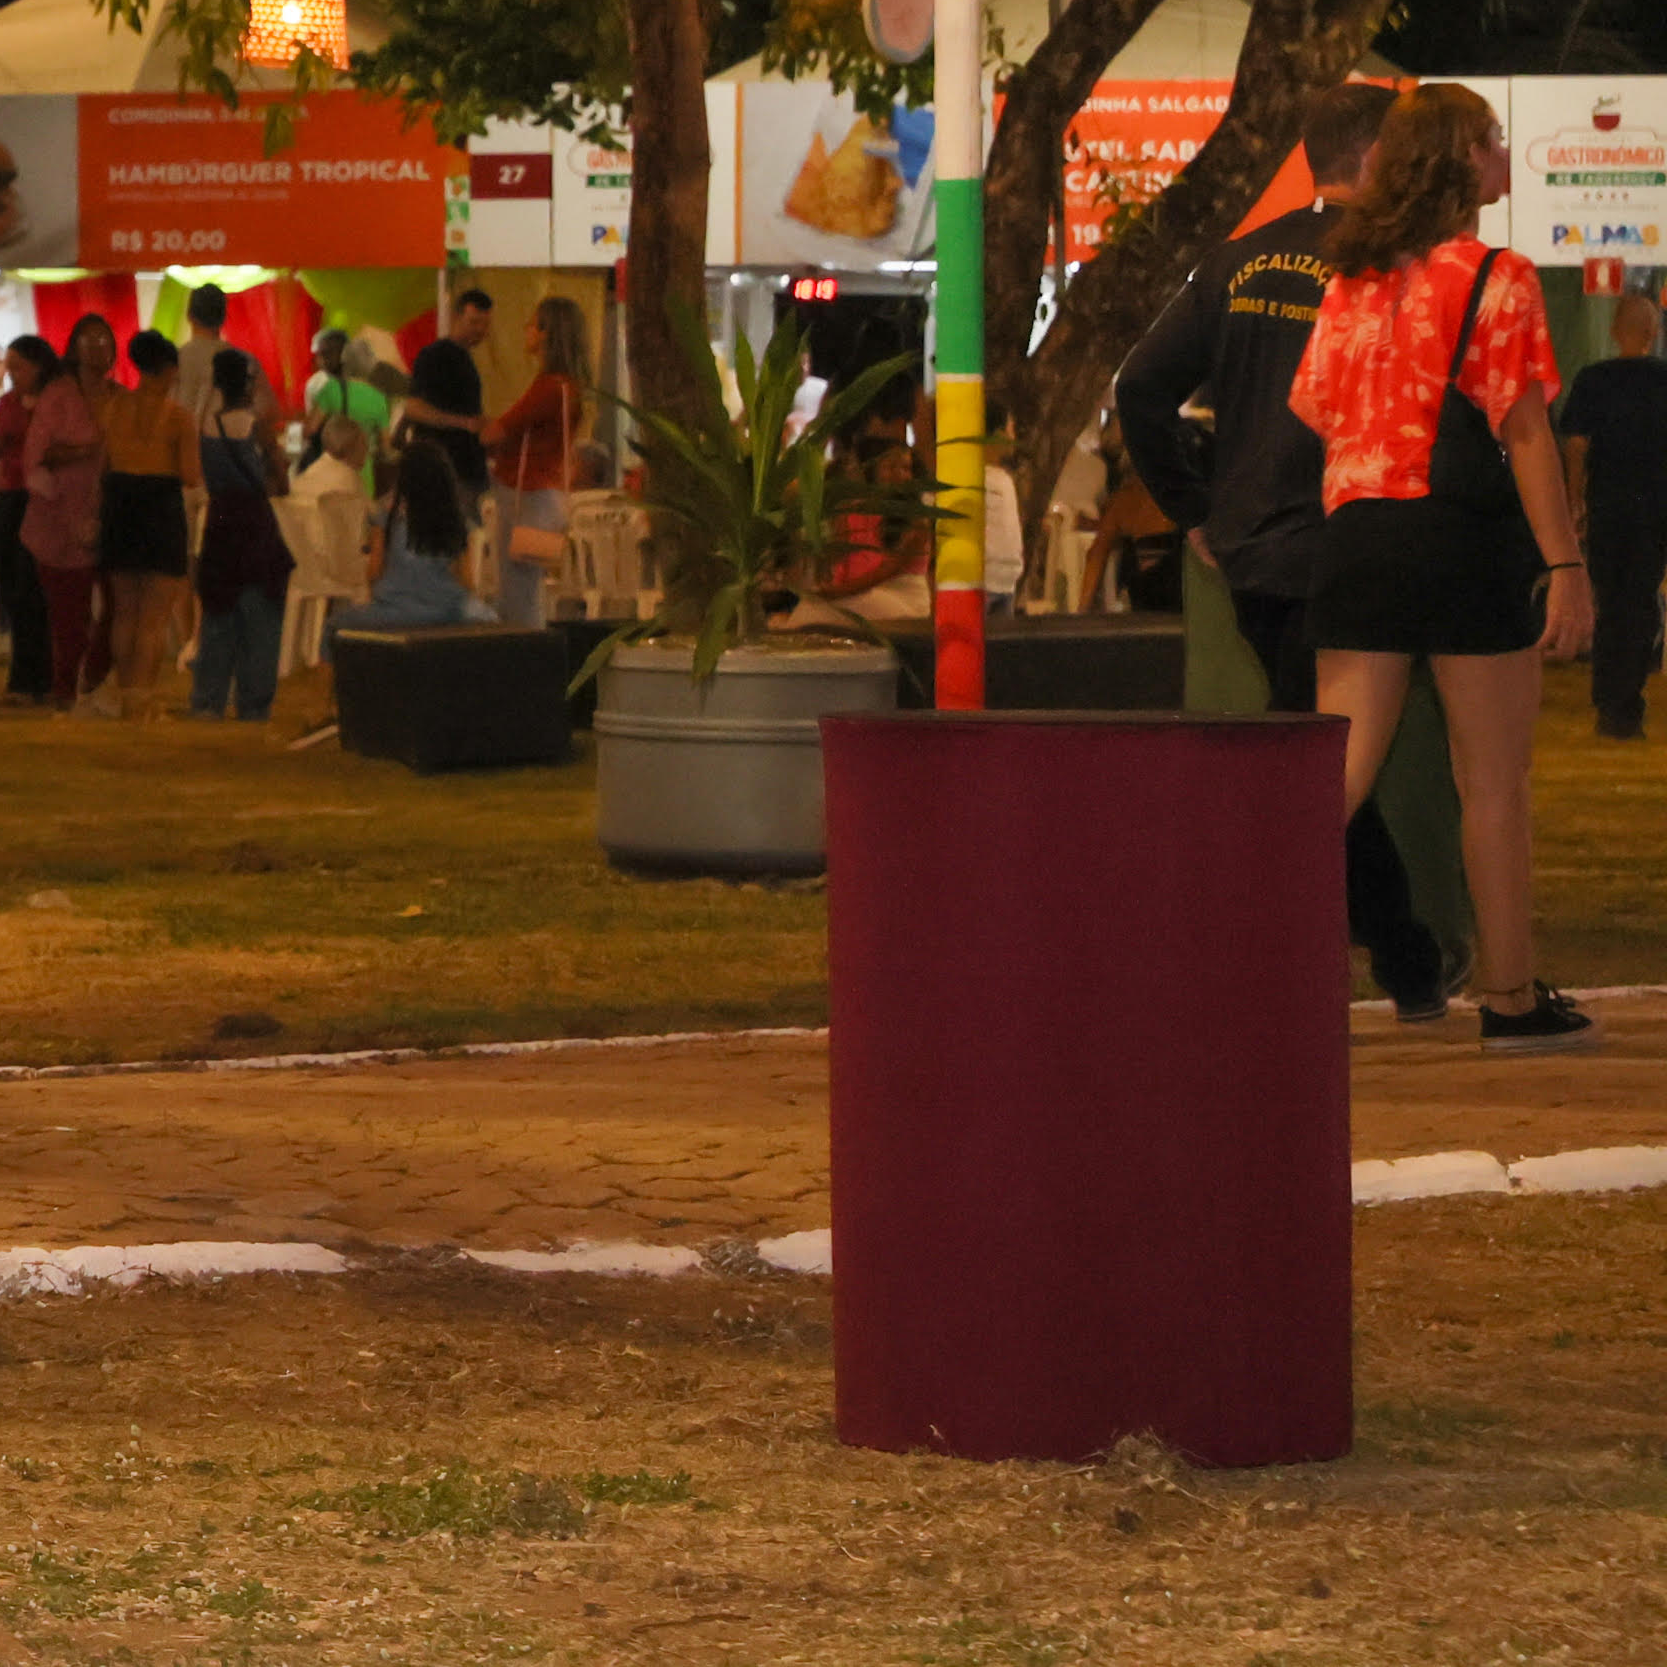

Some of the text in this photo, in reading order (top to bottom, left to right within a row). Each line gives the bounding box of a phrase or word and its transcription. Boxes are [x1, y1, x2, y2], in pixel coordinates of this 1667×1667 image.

[1147, 96, 1230, 113] SALGAD
[298, 159, 431, 184] TROPICAL
[498, 164, 526, 185] 27
[152, 229, 227, 254] 20,00
[1553, 224, 1660, 247] PALMAS
